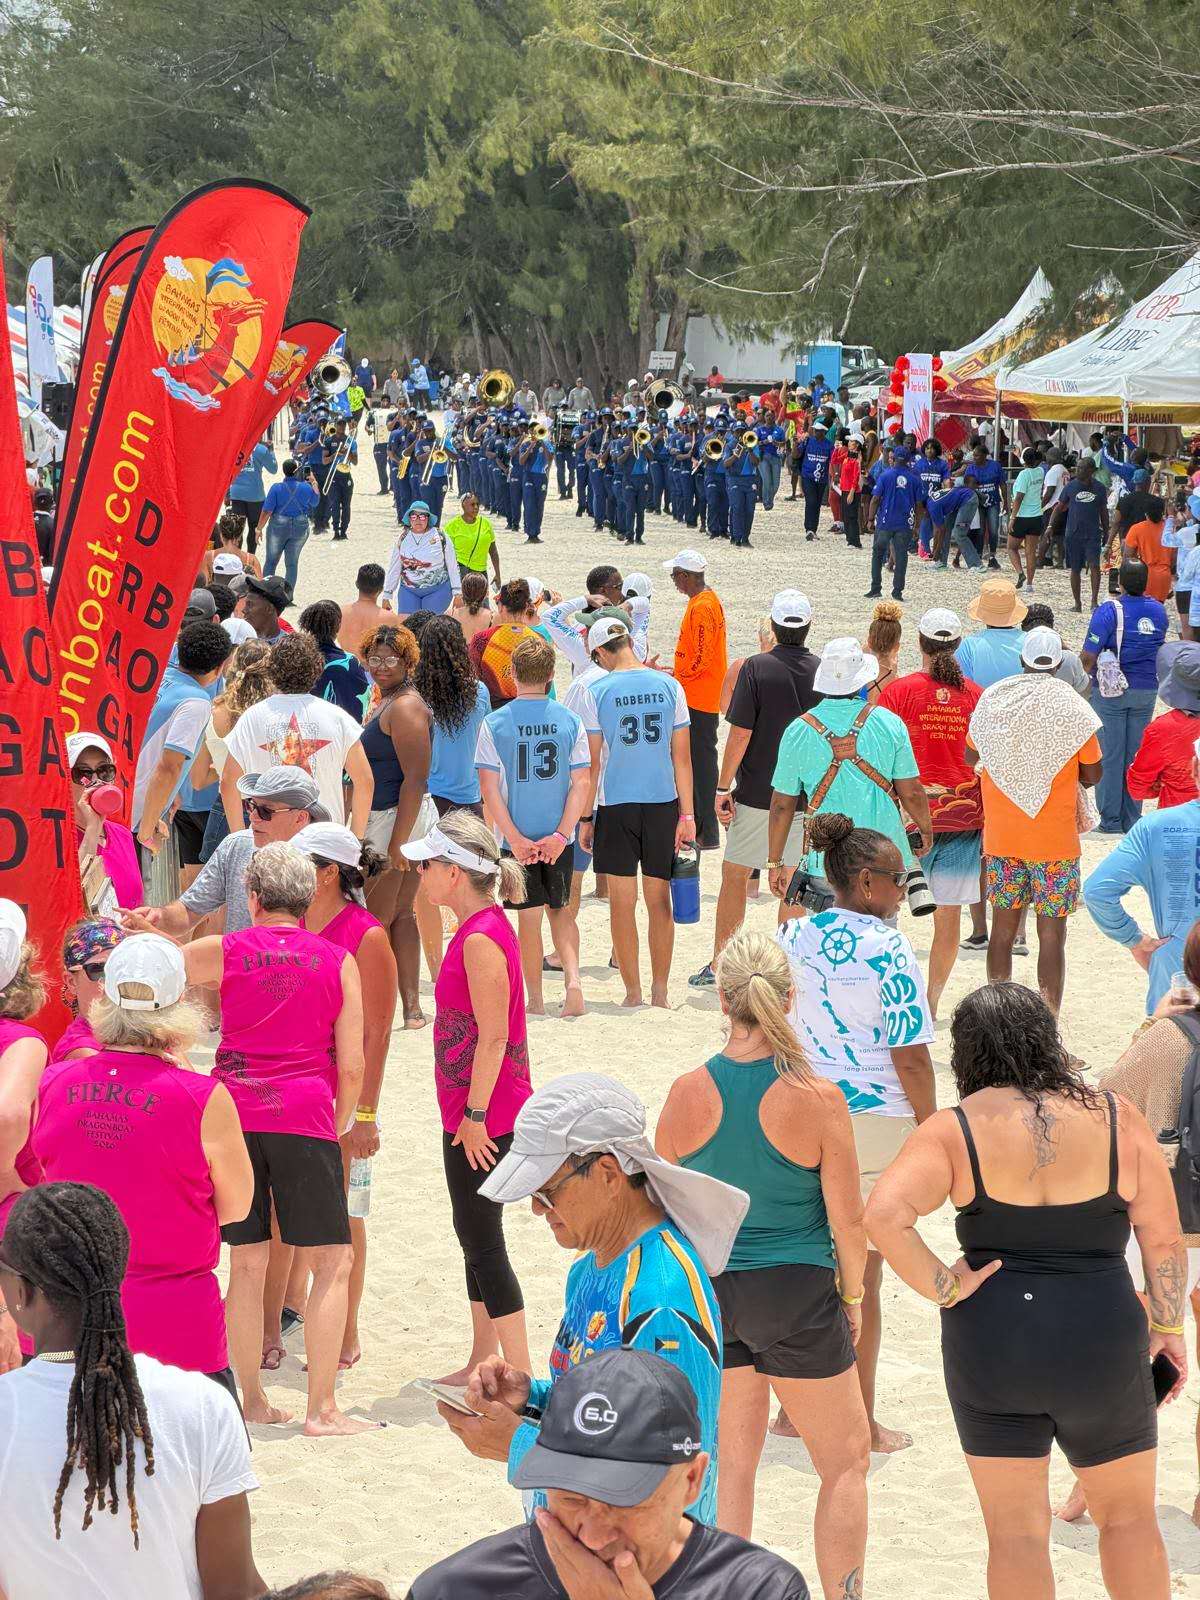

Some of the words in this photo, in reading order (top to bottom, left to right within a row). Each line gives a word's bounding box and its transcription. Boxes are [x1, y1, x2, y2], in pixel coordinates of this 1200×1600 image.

[1062, 379, 1079, 393] LIBRE
[1082, 411, 1124, 424] UNIQUELY
[1127, 413, 1174, 424] BAHAMIAN
[615, 693, 665, 707] ROBERTS
[926, 704, 961, 714] BAHAMAS
[517, 723, 558, 736] YOUNG
[620, 711, 663, 746] 35
[929, 732, 958, 741] FESTIVAL
[516, 739, 559, 782] 13
[241, 949, 323, 973] FIERCE
[844, 1065, 860, 1073] long
[67, 1081, 161, 1117] FIERCE
[86, 1111, 129, 1123] BAHAMAS
[86, 1130, 123, 1141] FESTIVAL
[584, 1406, 618, 1423] 6.0
